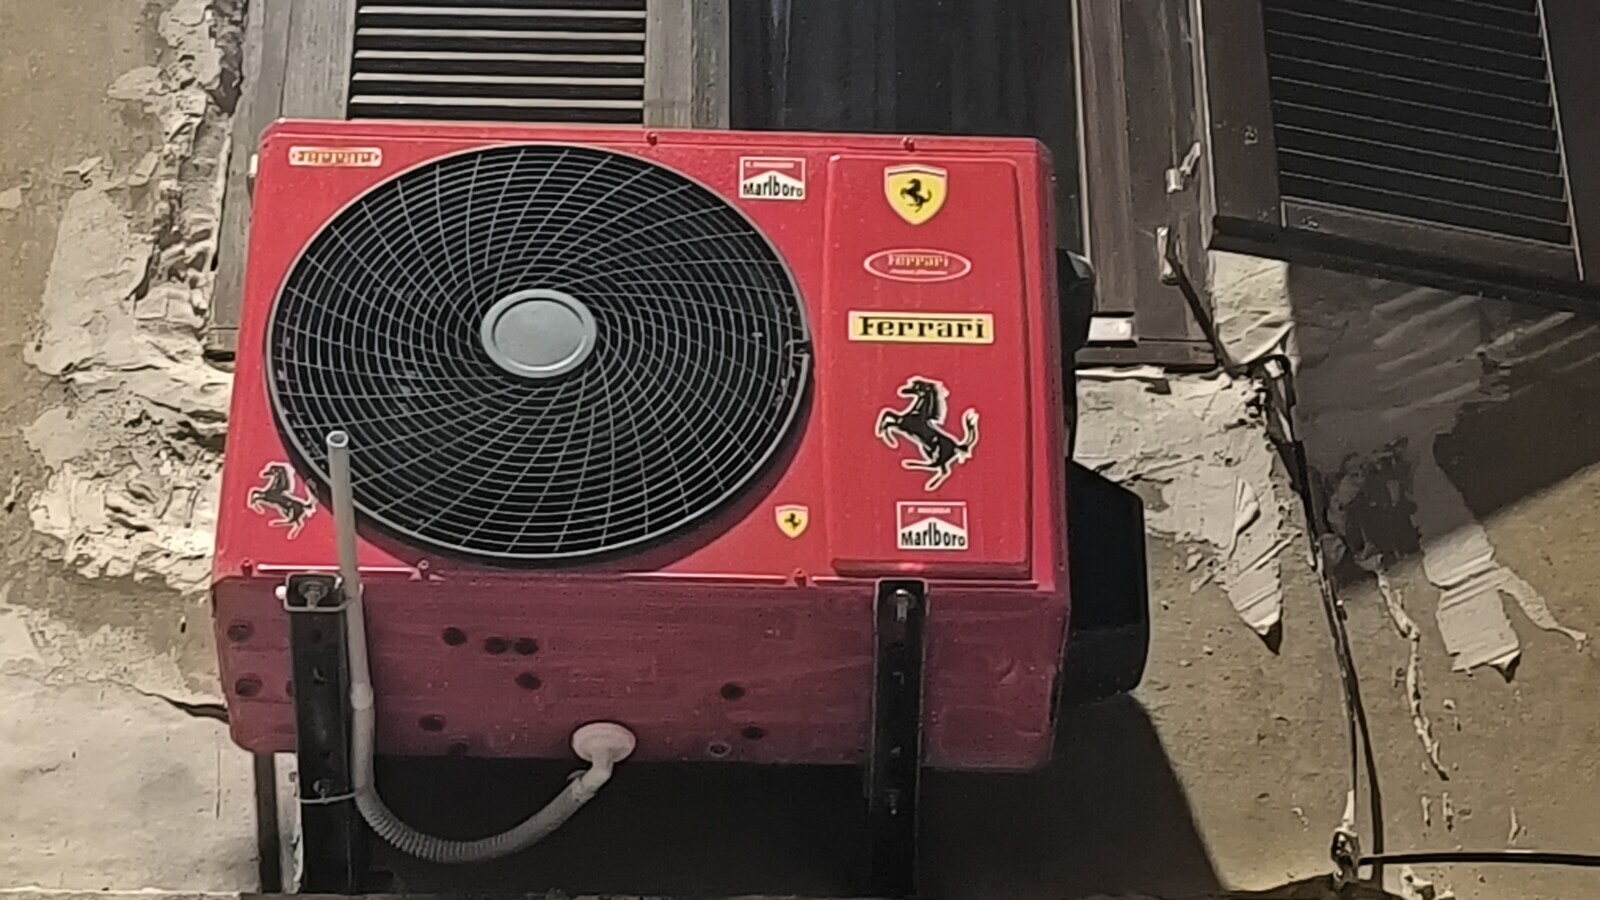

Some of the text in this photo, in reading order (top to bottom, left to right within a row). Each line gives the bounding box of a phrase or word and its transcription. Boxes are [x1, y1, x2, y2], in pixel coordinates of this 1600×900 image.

[743, 175, 804, 197] Marlboro
[858, 316, 985, 339] Ferrari
[901, 522, 966, 547] Marlboro
